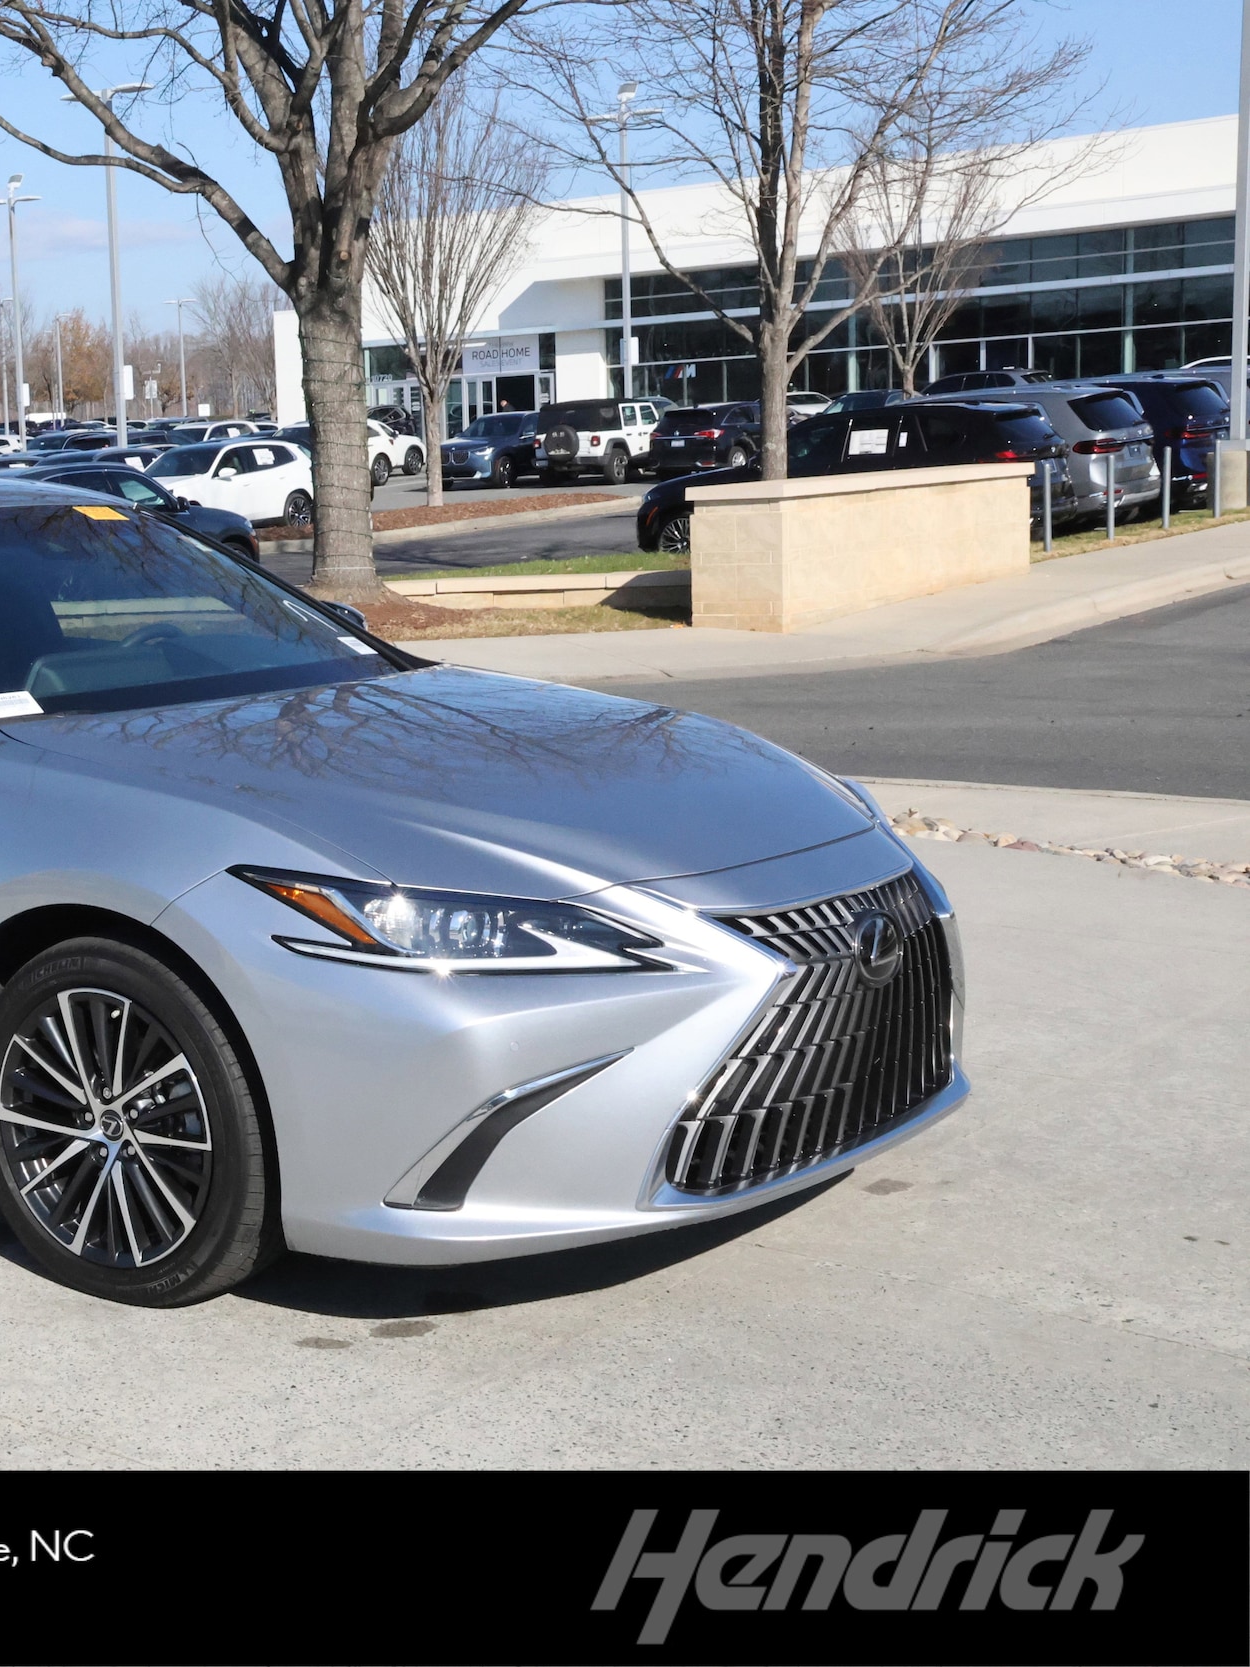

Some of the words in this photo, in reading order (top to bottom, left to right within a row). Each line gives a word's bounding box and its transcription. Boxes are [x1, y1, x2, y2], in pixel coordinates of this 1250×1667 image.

[472, 349, 499, 360] ROAD
[501, 347, 531, 358] HOME
[501, 358, 523, 366] EVENT
